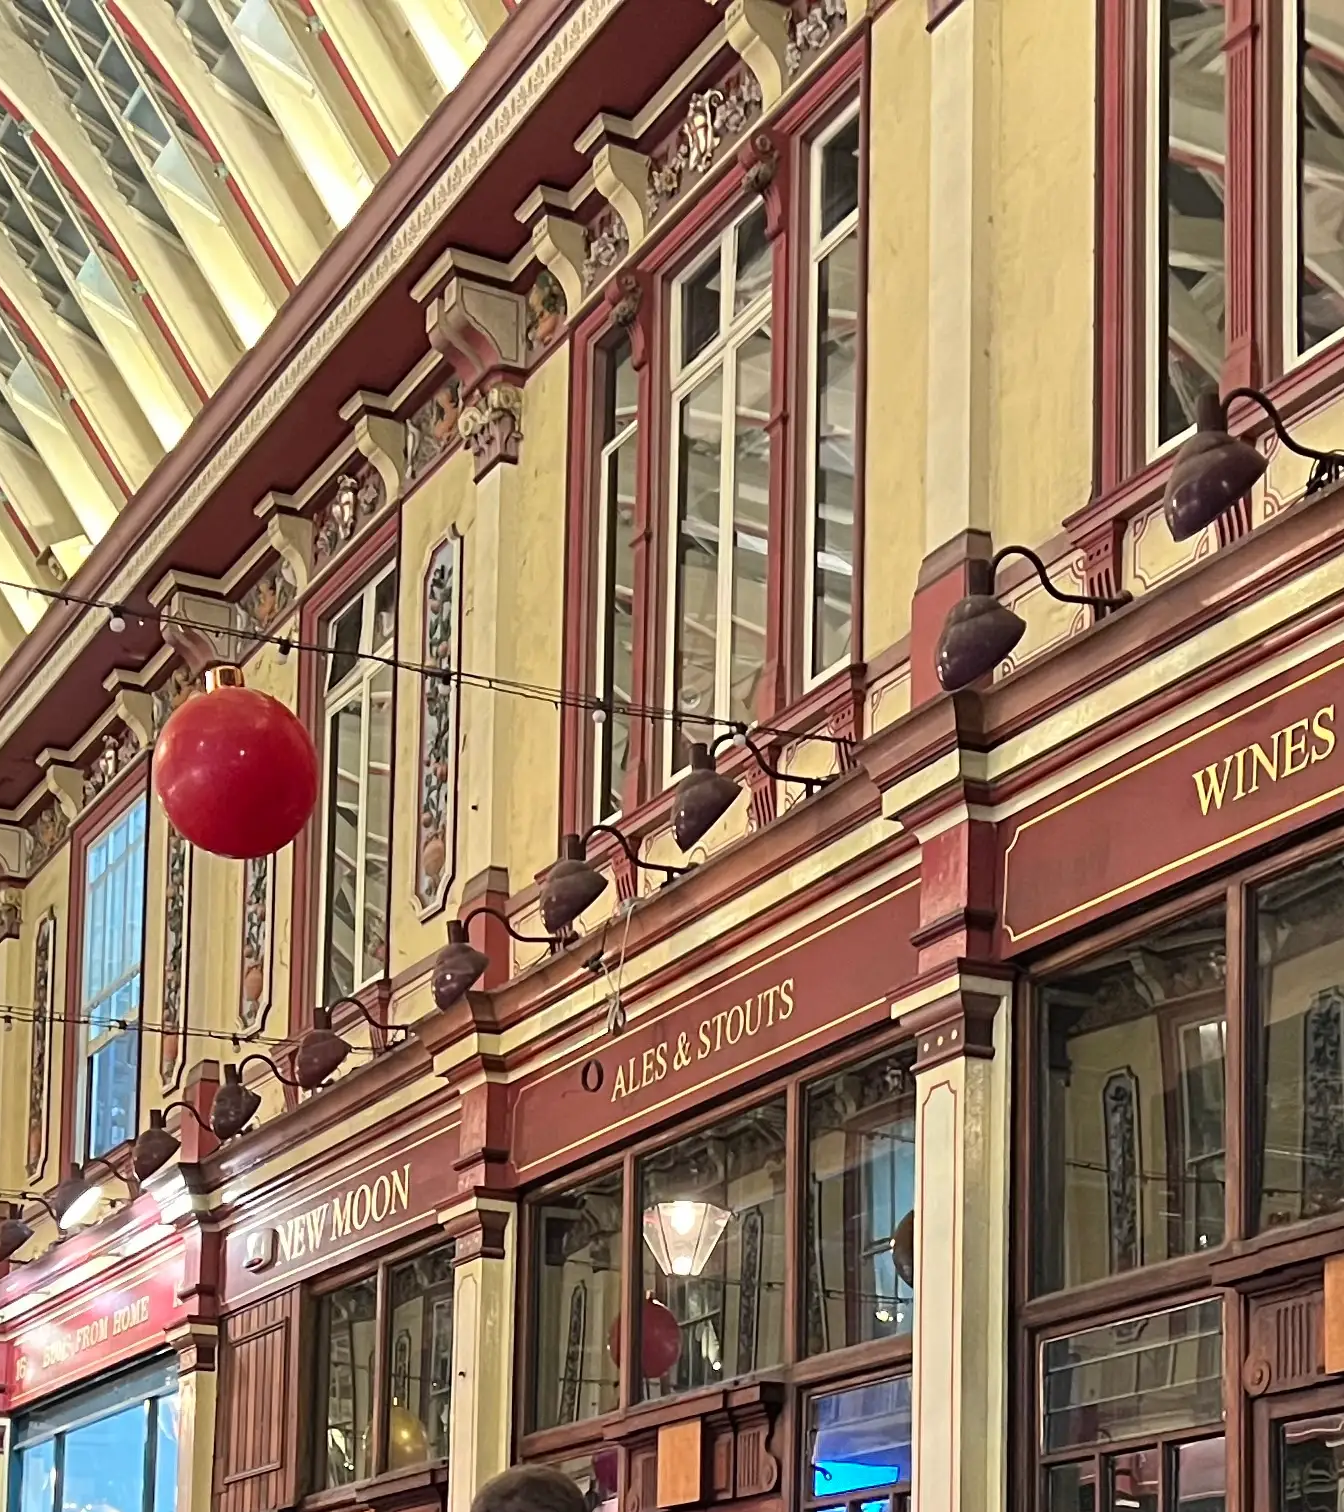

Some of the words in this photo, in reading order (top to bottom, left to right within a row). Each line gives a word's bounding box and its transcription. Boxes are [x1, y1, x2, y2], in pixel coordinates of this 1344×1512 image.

[1192, 704, 1337, 817] WINES
[611, 1041, 668, 1103] ALES
[673, 1031, 692, 1072] &
[697, 977, 795, 1061] STOUTS
[275, 1202, 330, 1267] NEW
[330, 1163, 412, 1242] MOON
[76, 1315, 109, 1357] FROM
[112, 1295, 151, 1337] HOME
